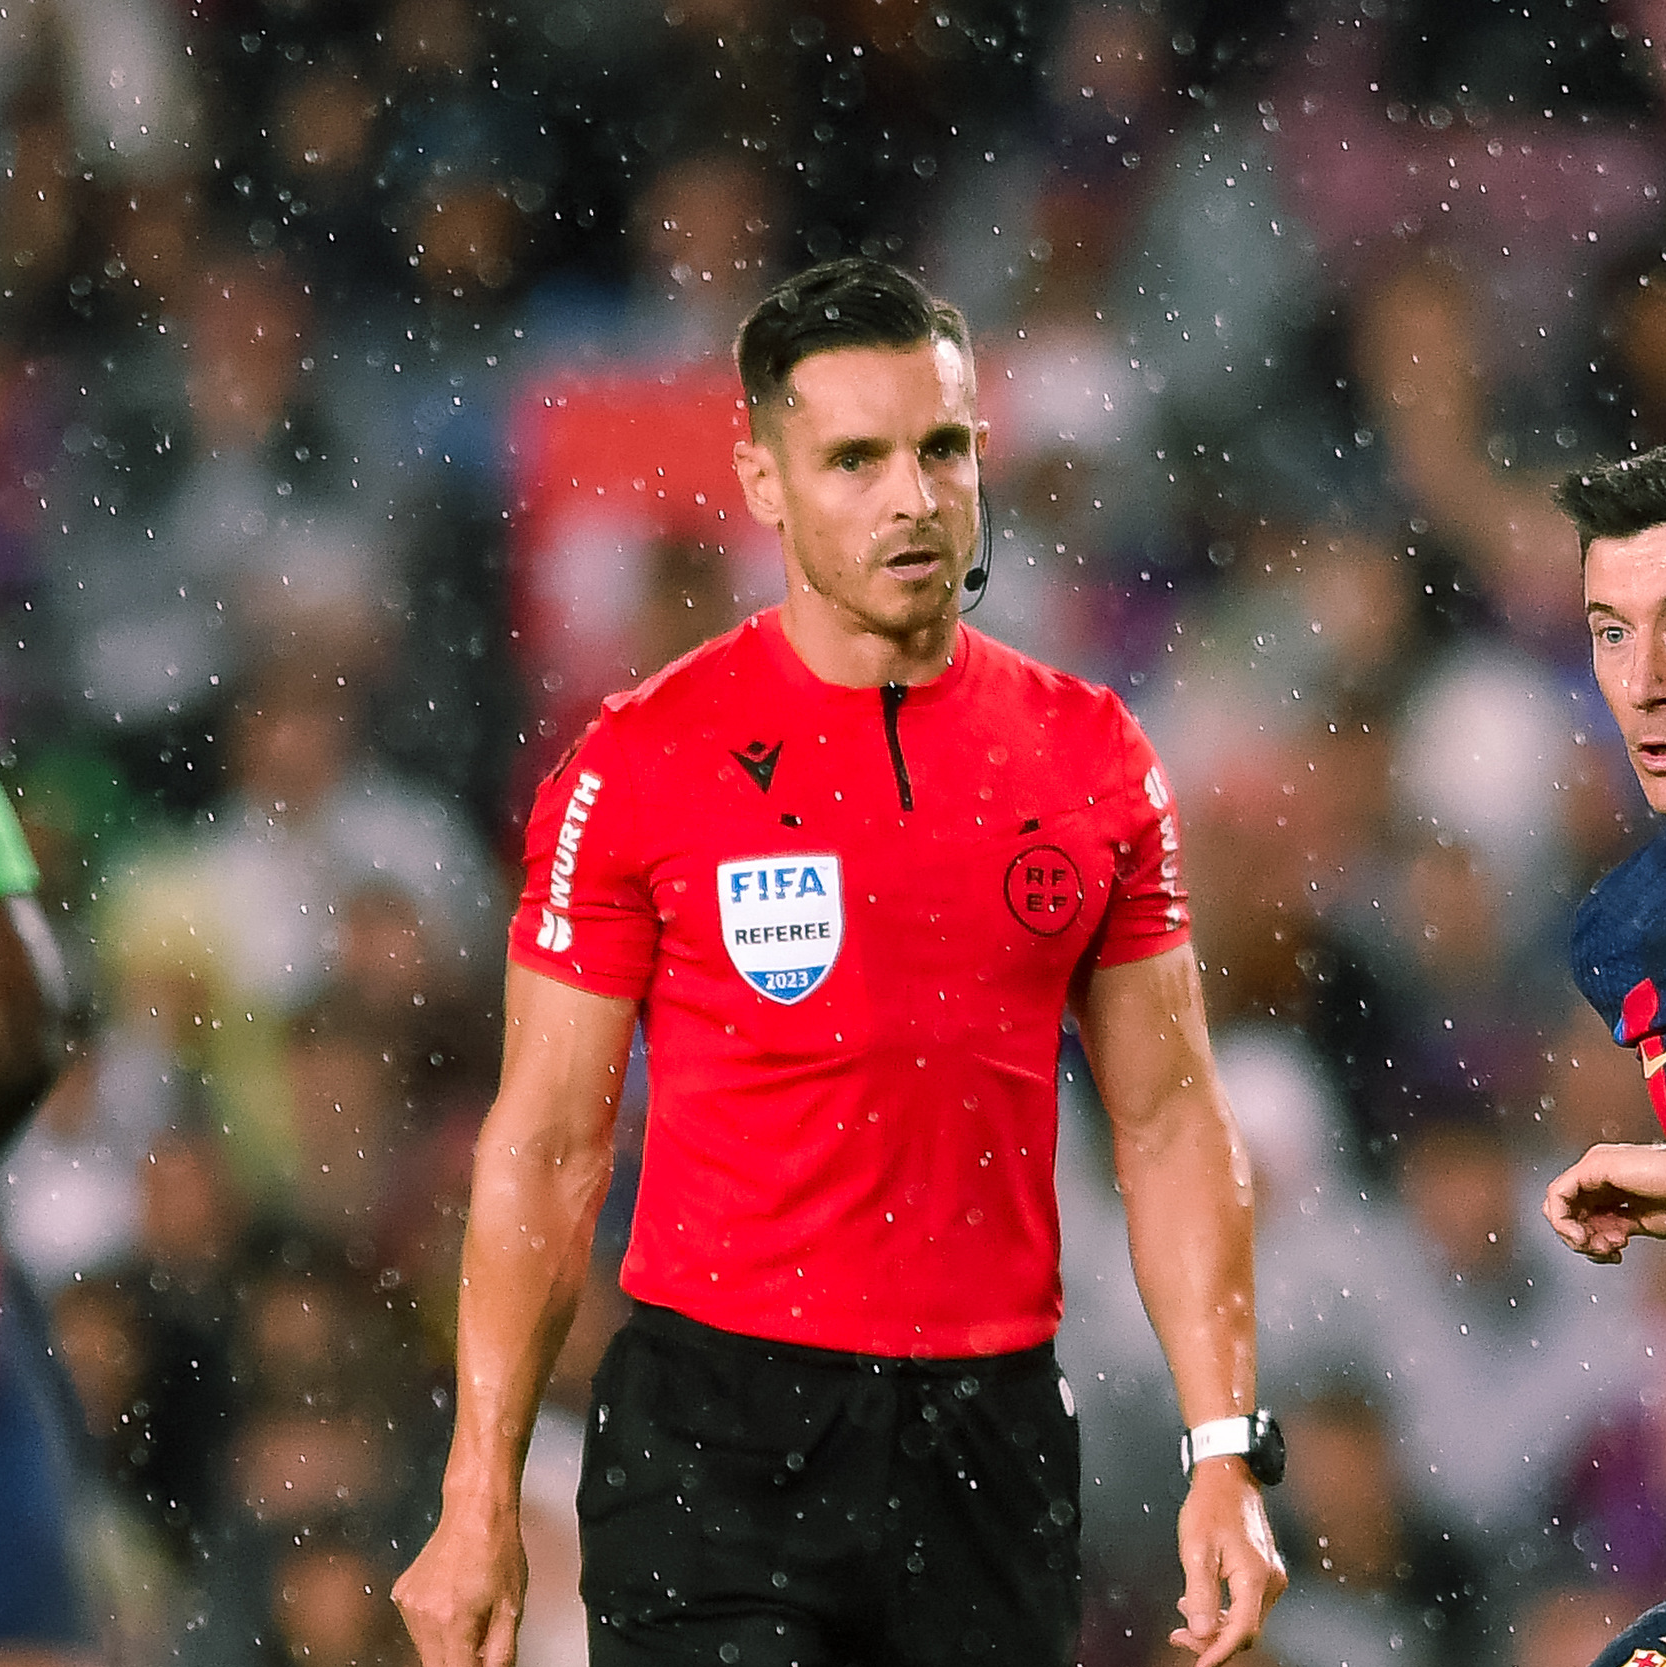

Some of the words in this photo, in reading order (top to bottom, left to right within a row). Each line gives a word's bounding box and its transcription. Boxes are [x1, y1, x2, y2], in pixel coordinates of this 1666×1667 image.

[730, 866, 827, 904] FIFA
[734, 921, 831, 946] REFEREE
[764, 971, 810, 990] 2023
